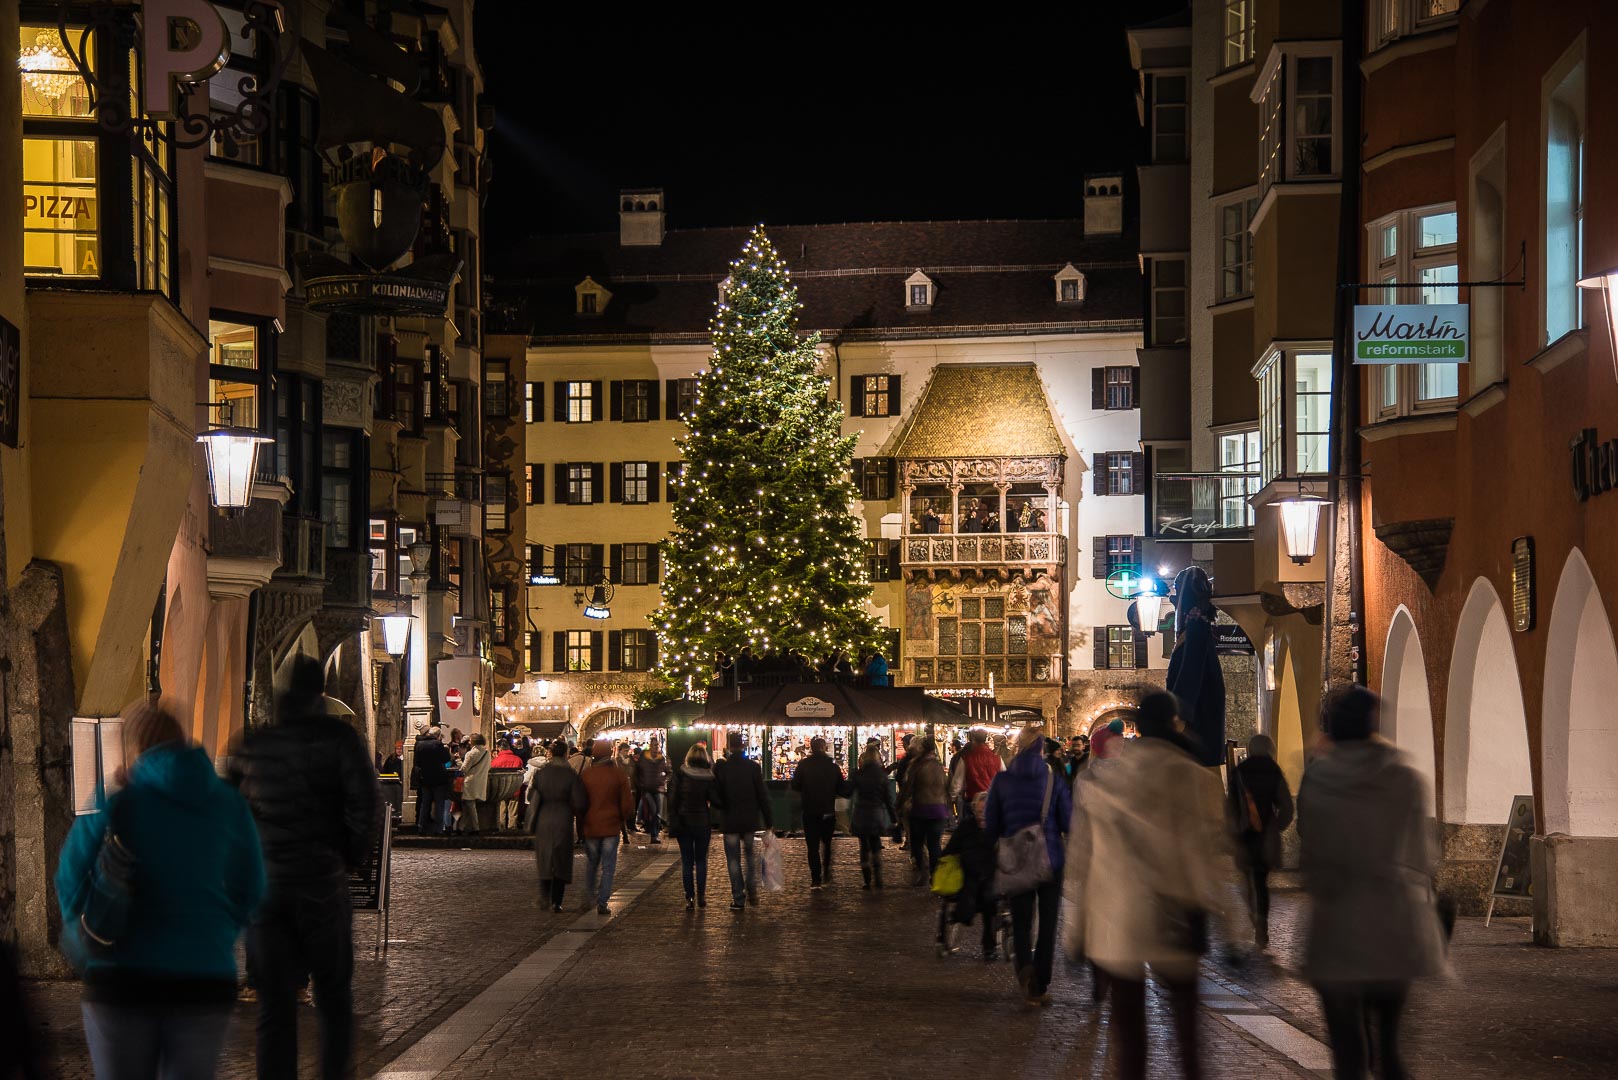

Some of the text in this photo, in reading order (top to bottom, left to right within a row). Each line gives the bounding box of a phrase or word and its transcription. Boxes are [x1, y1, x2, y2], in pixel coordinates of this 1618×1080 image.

[24, 196, 92, 219] PIZZA
[372, 284, 446, 303] KOLONIALWAREN
[1358, 312, 1465, 340] Martin
[1366, 344, 1456, 355] reformstark
